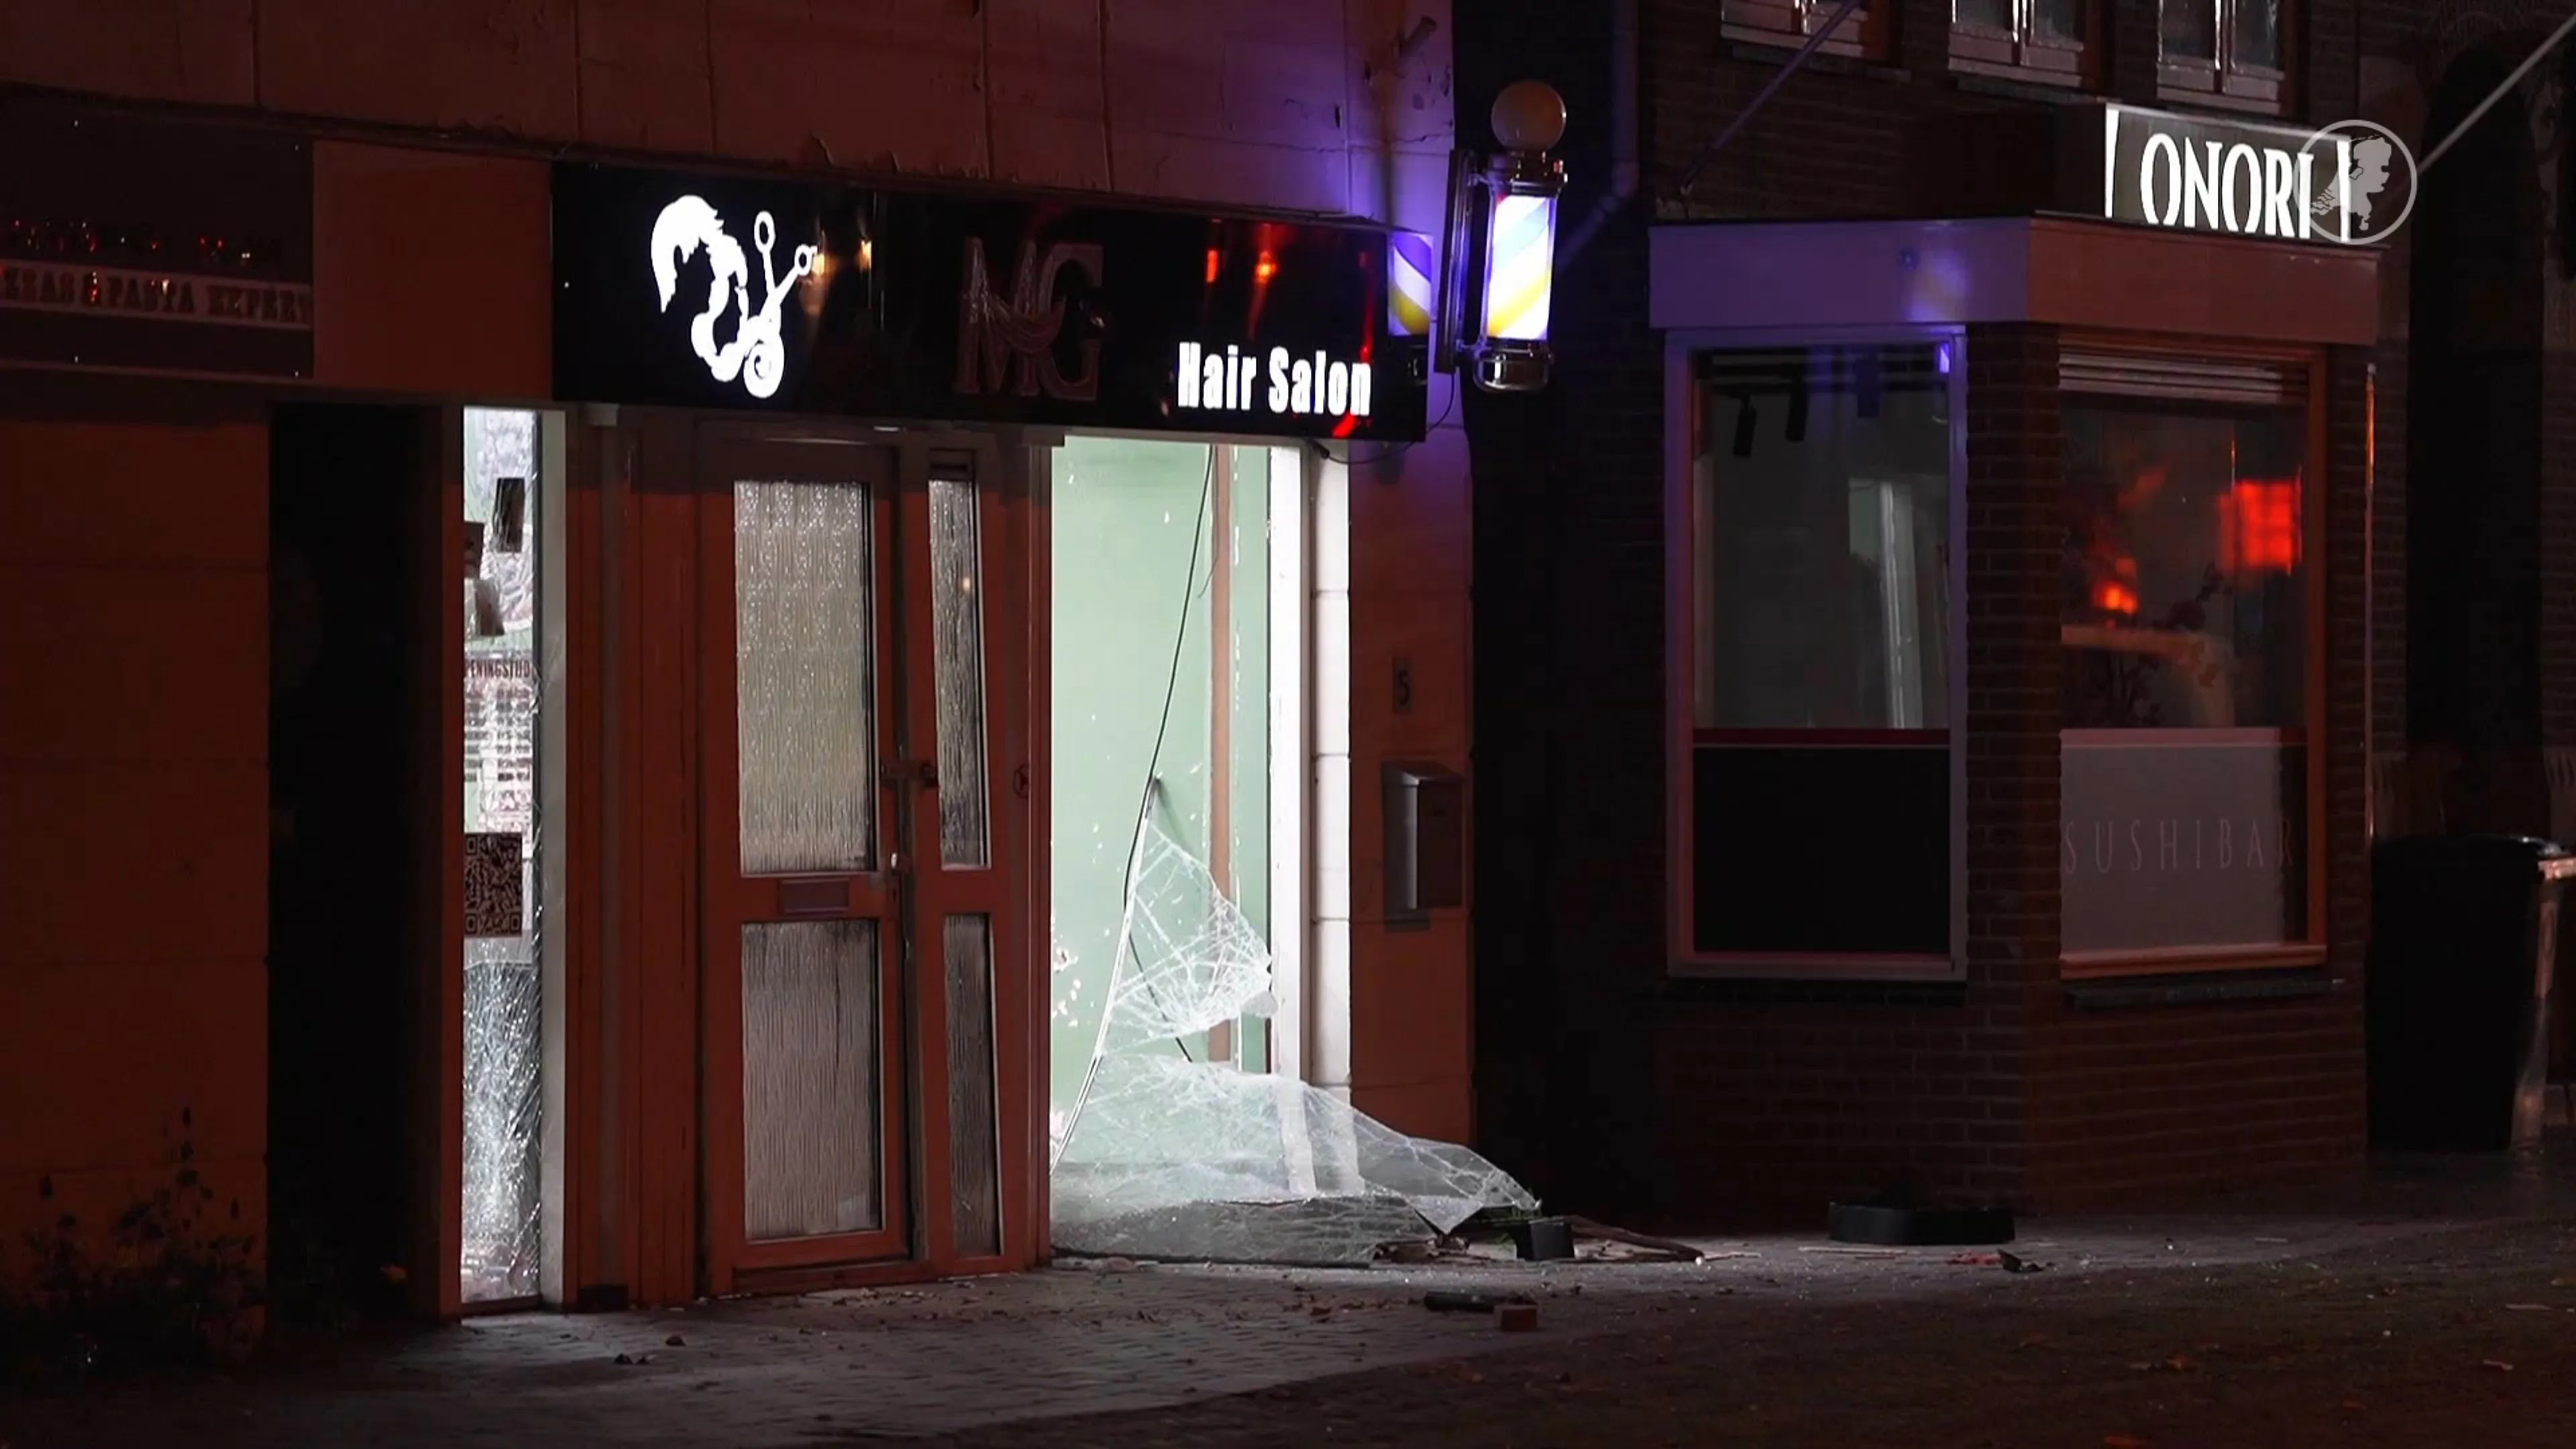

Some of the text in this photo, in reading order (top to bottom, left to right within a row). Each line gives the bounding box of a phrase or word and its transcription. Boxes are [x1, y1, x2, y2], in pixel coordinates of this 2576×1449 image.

[2140, 133, 2314, 239] ONORI
[1177, 341, 1372, 417] Hair Salon
